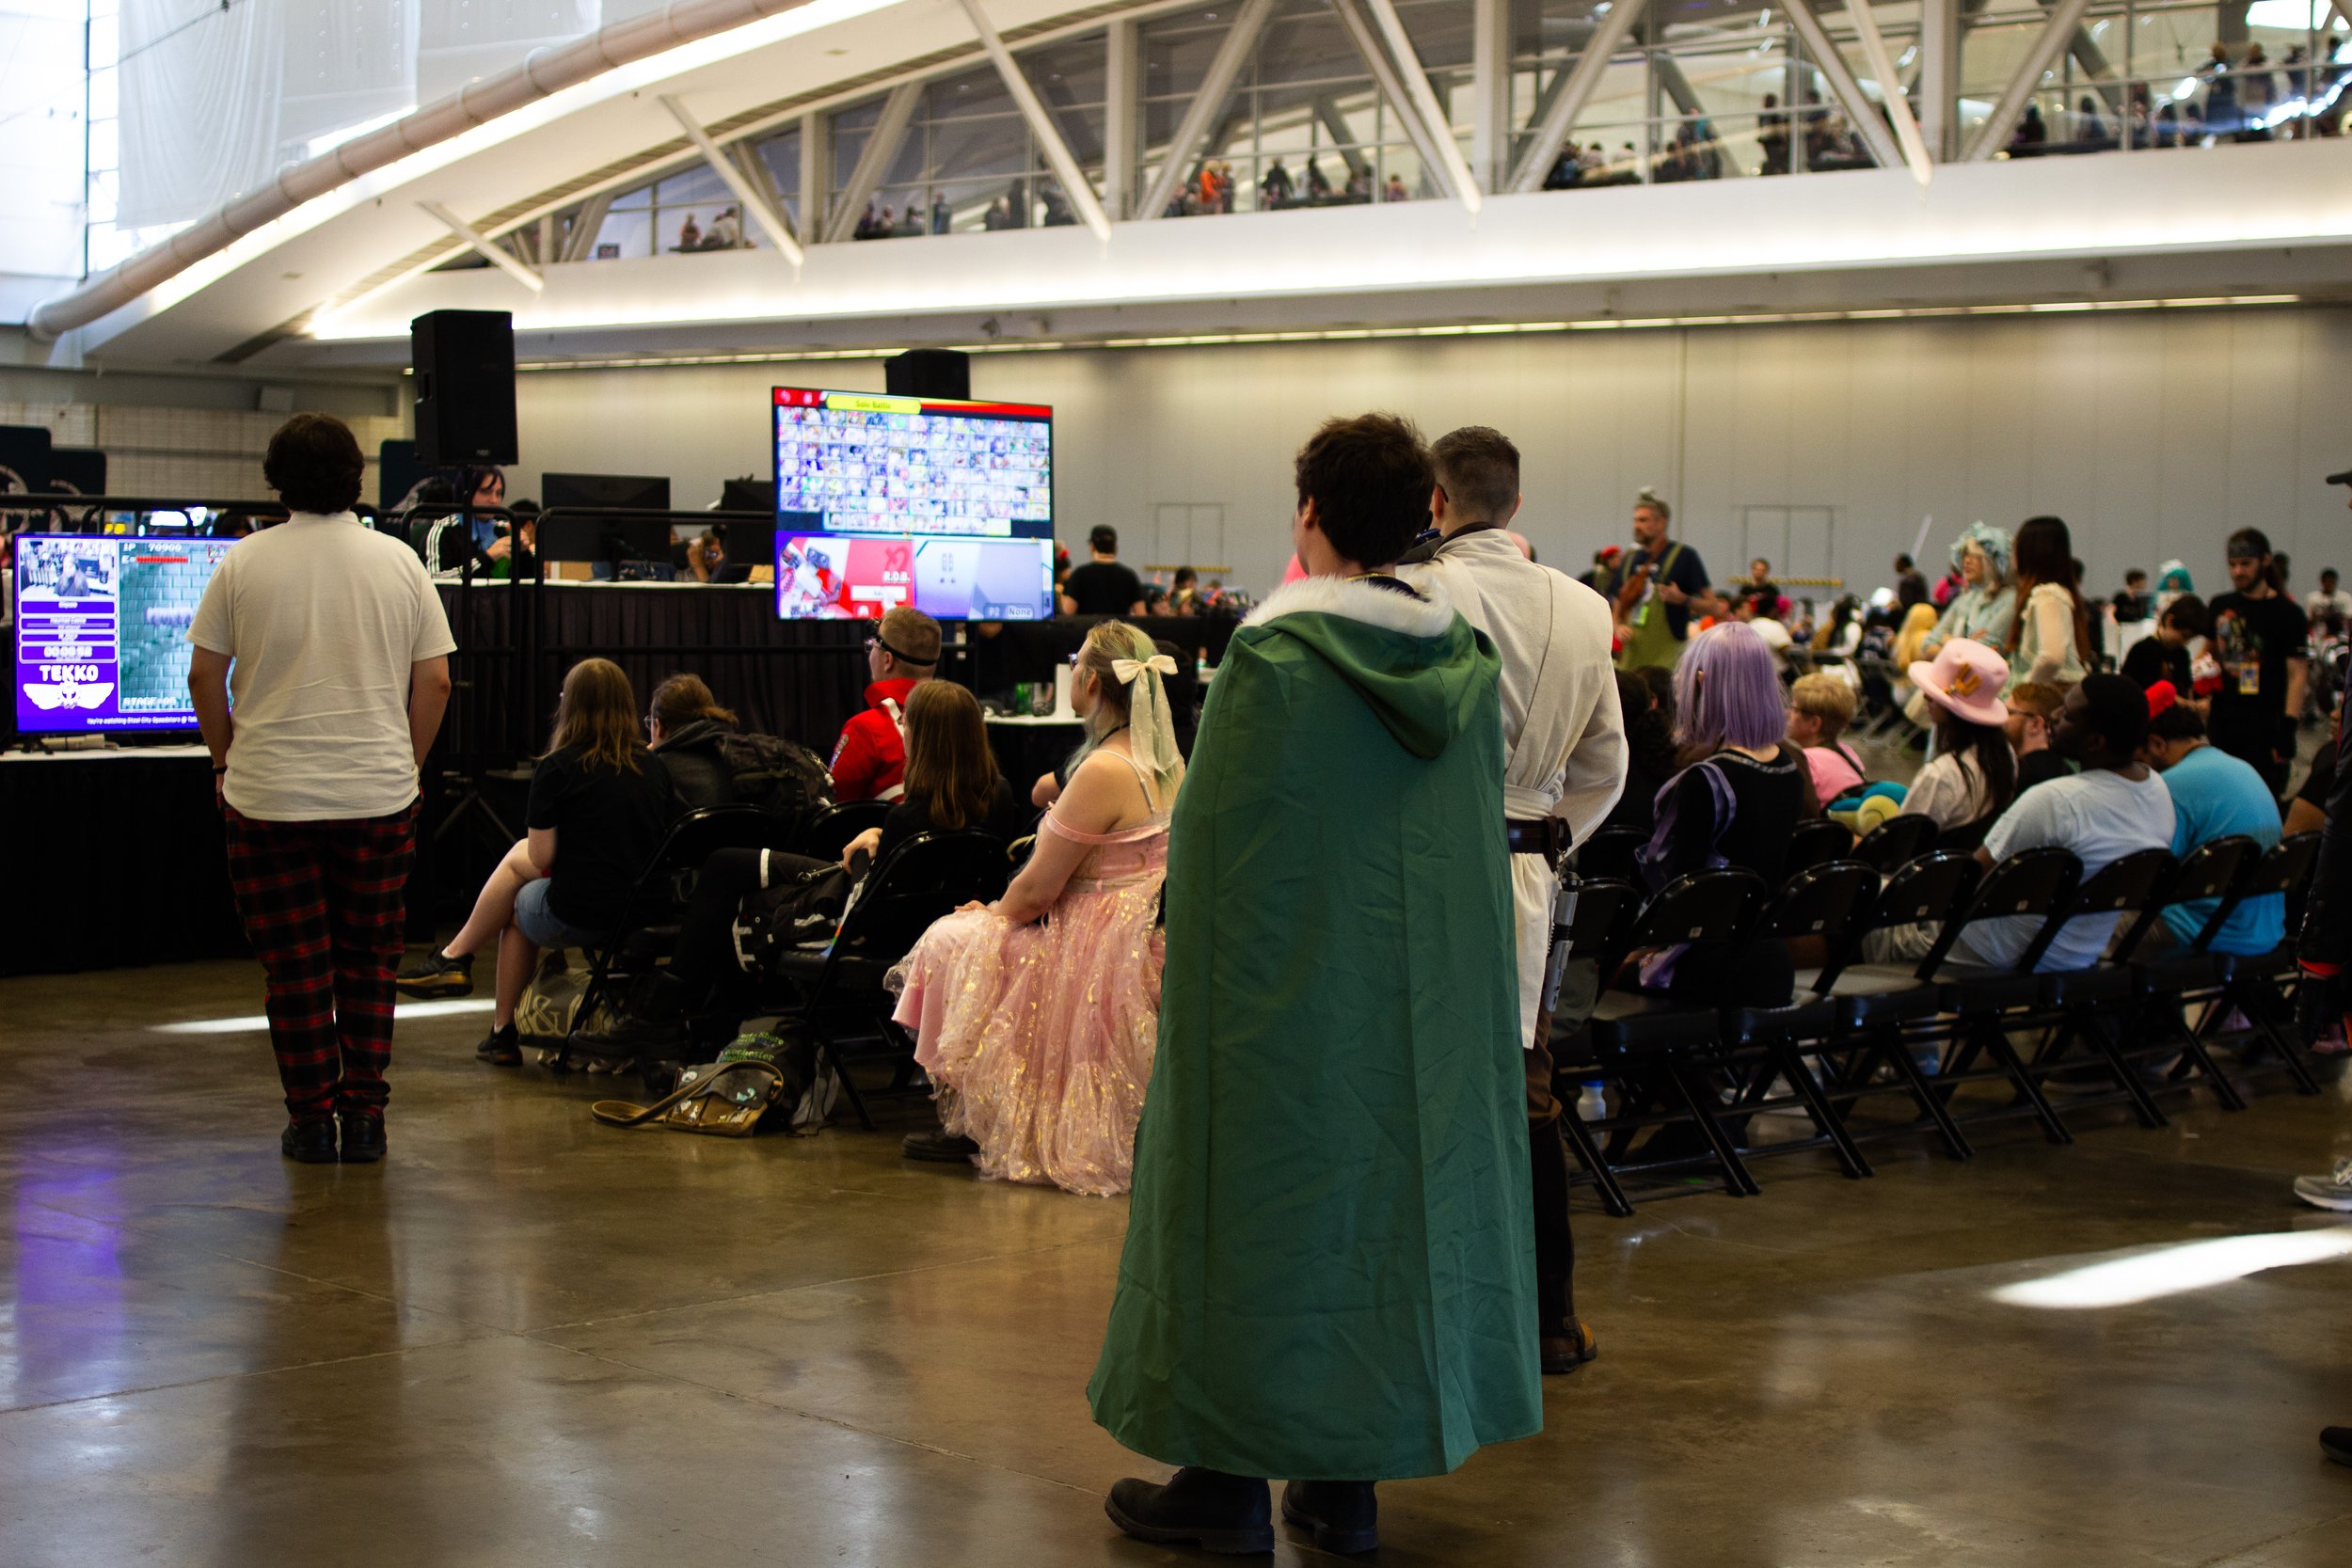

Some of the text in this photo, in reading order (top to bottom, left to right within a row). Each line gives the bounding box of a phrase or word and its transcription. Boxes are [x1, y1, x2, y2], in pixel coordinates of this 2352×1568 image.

[872, 401, 892, 410] Battle
[882, 570, 911, 582] R.O.B.
[1009, 607, 1032, 617] None
[39, 664, 99, 682] TEKKO
